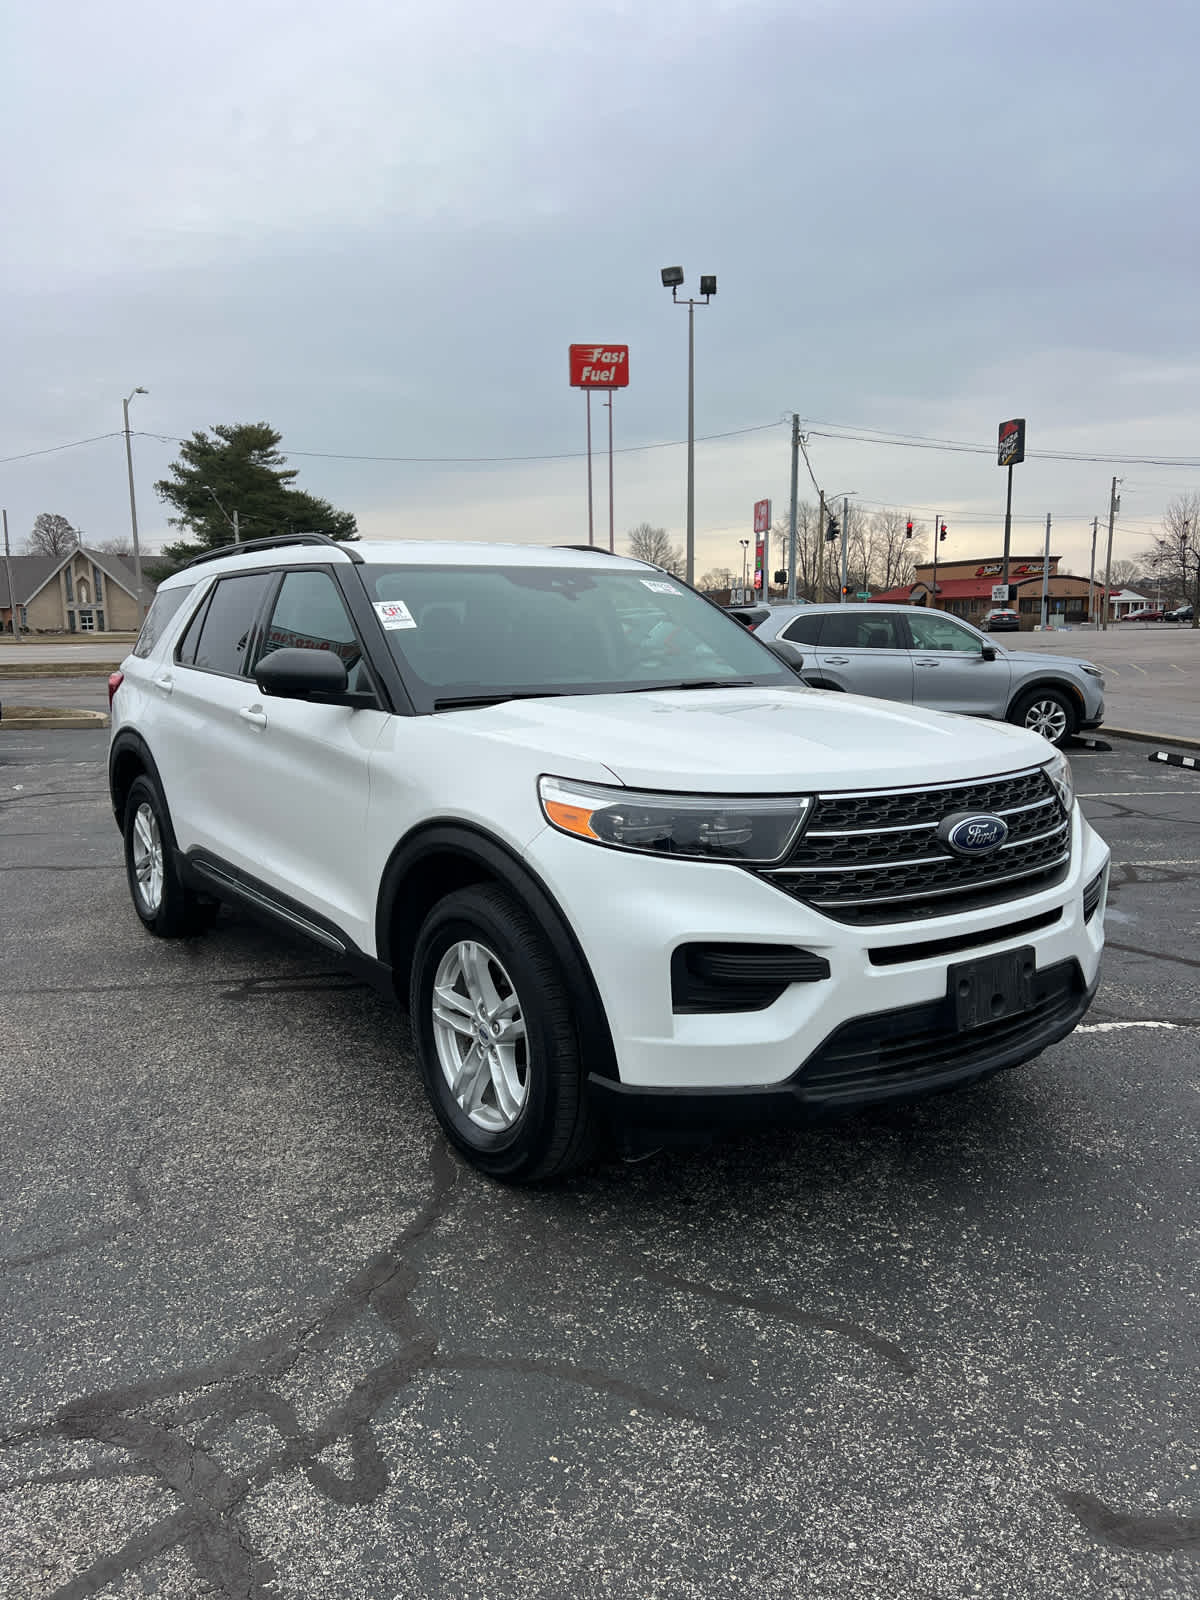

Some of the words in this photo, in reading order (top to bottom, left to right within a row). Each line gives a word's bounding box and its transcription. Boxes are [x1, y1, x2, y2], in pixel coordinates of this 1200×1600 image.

[591, 348, 625, 363] Fast
[581, 366, 616, 381] Fuel
[966, 823, 998, 846] Ford
